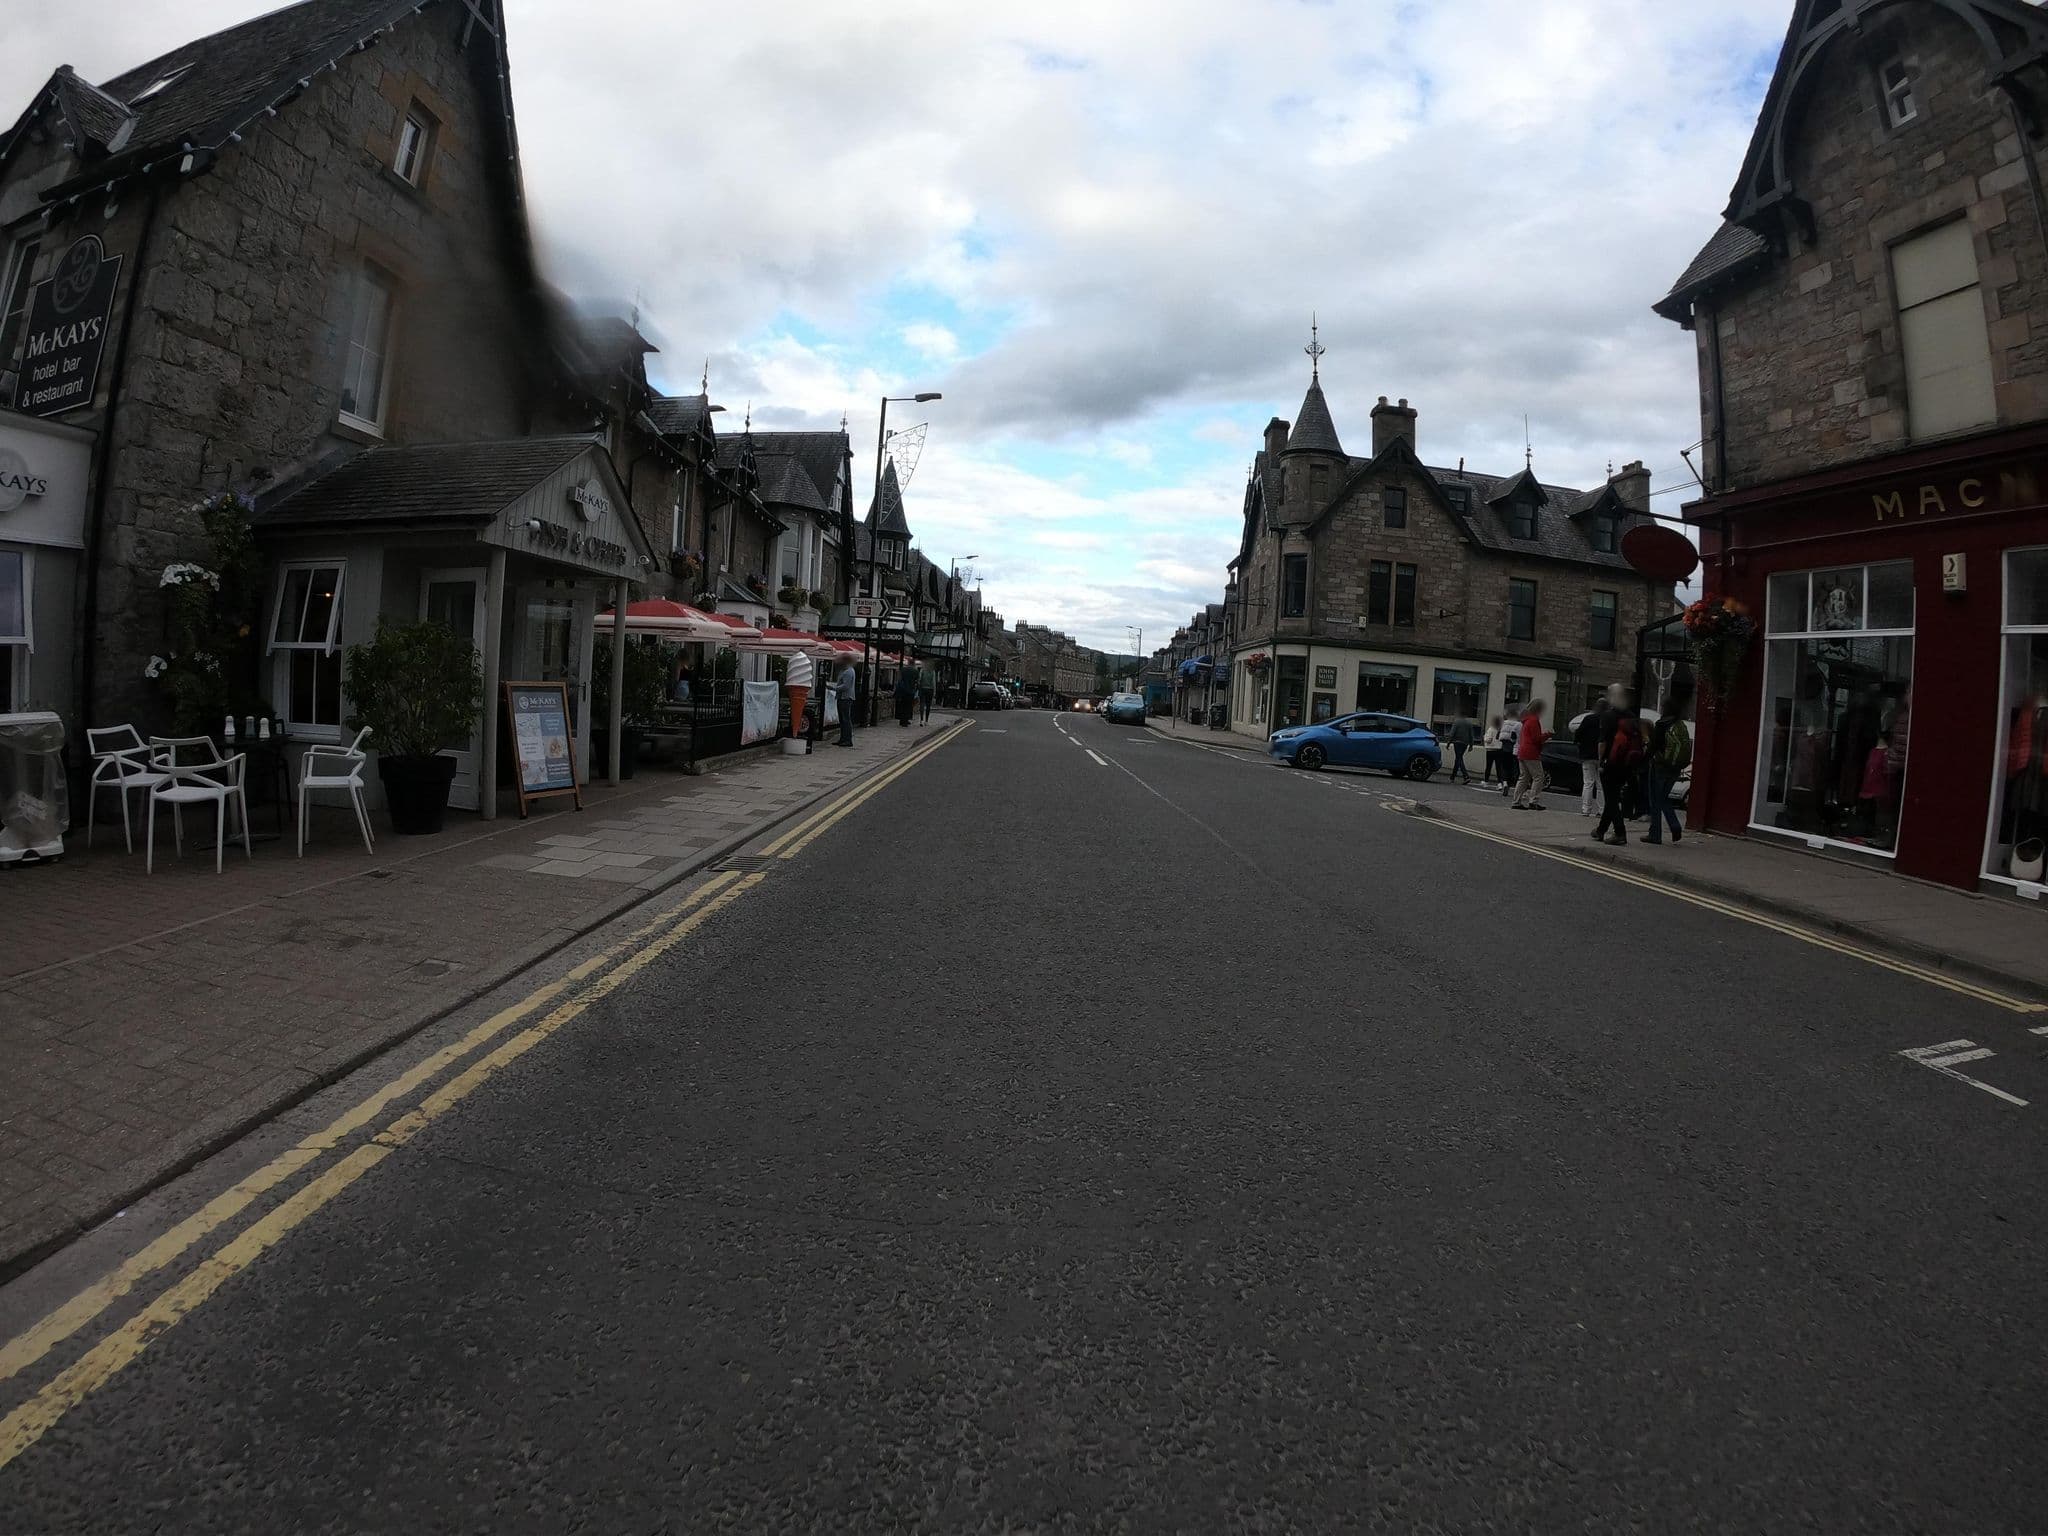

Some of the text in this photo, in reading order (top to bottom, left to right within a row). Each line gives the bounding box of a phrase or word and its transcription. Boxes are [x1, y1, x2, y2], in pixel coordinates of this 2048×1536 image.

[26, 316, 103, 360] McKAYS
[32, 356, 82, 383] hotel bar
[22, 377, 84, 408] & restaurant
[853, 599, 877, 607] Station
